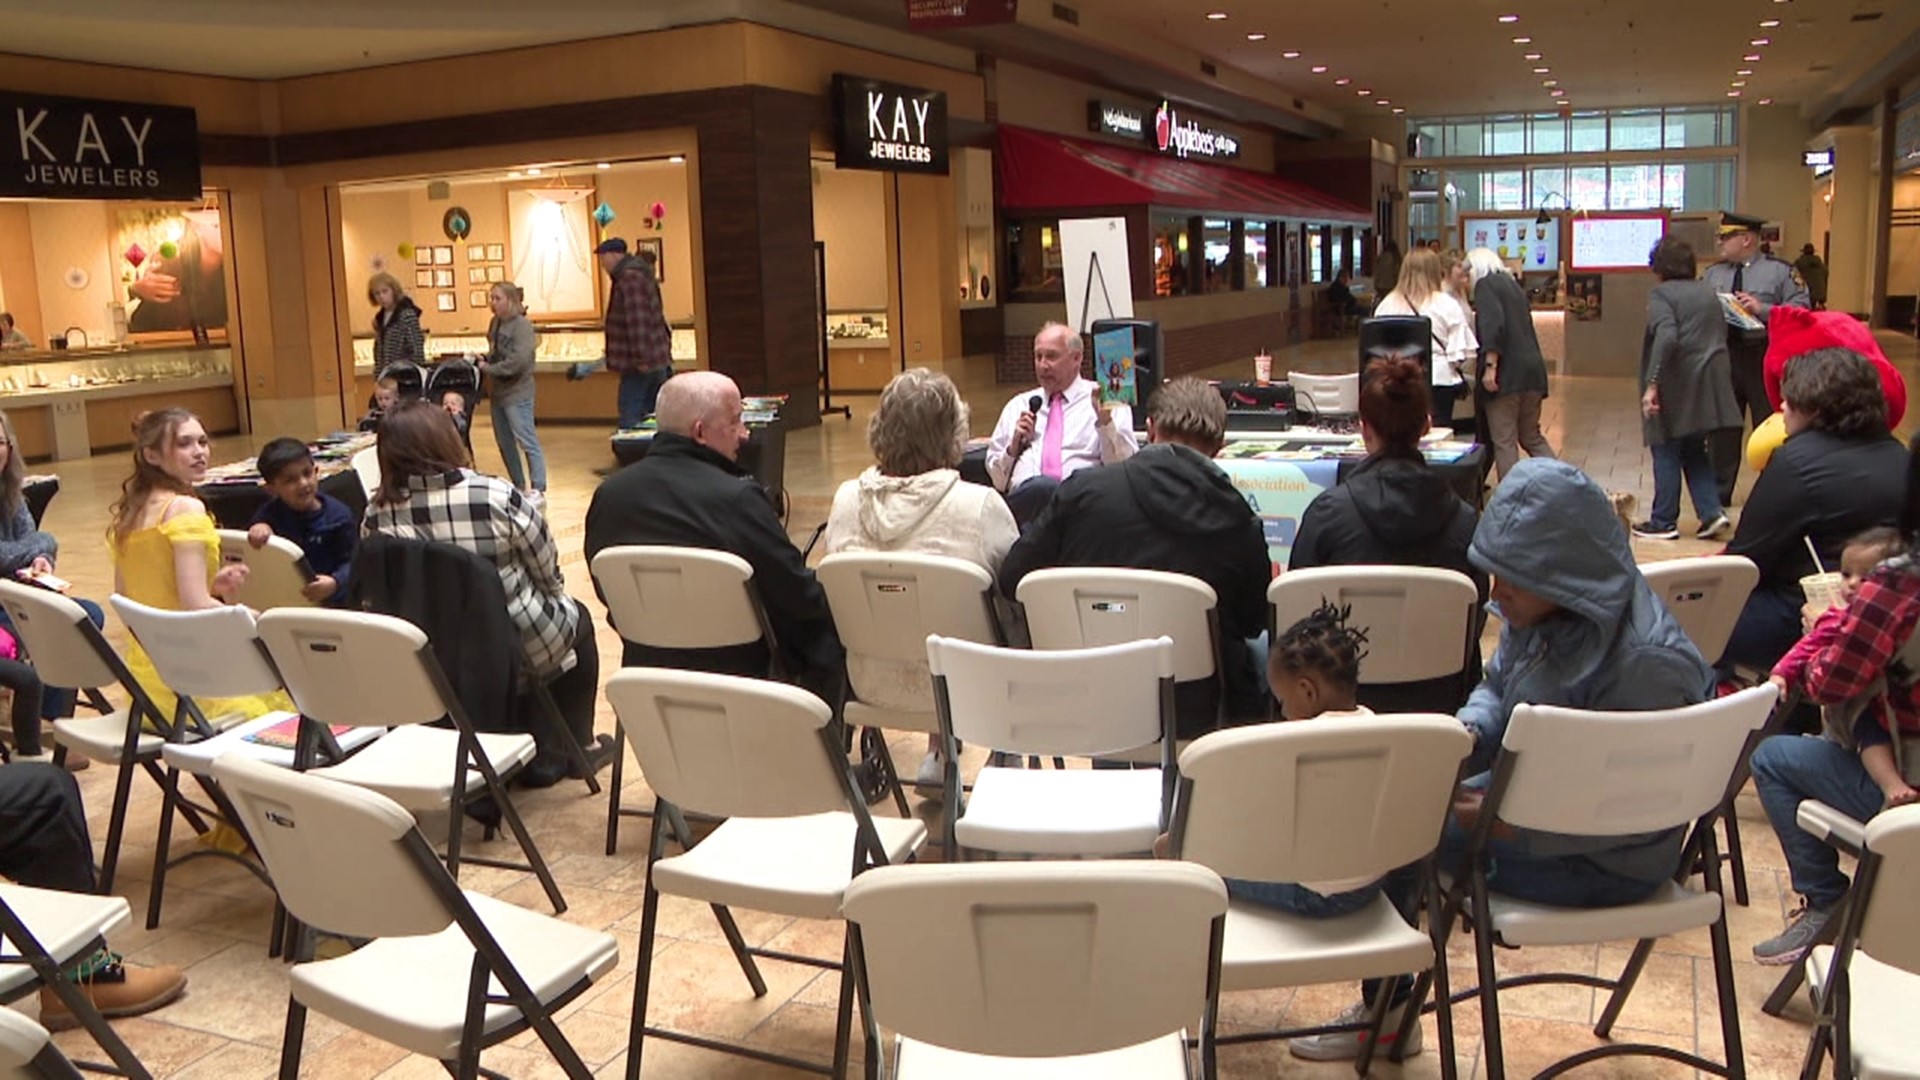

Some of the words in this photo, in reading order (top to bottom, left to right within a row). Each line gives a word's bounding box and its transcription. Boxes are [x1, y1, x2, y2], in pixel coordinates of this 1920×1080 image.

[16, 107, 153, 166] KAY
[868, 91, 929, 145] KAY
[1169, 110, 1214, 158] Applebee's
[24, 165, 160, 187] JEWELERS
[869, 141, 931, 163] JEWELERS
